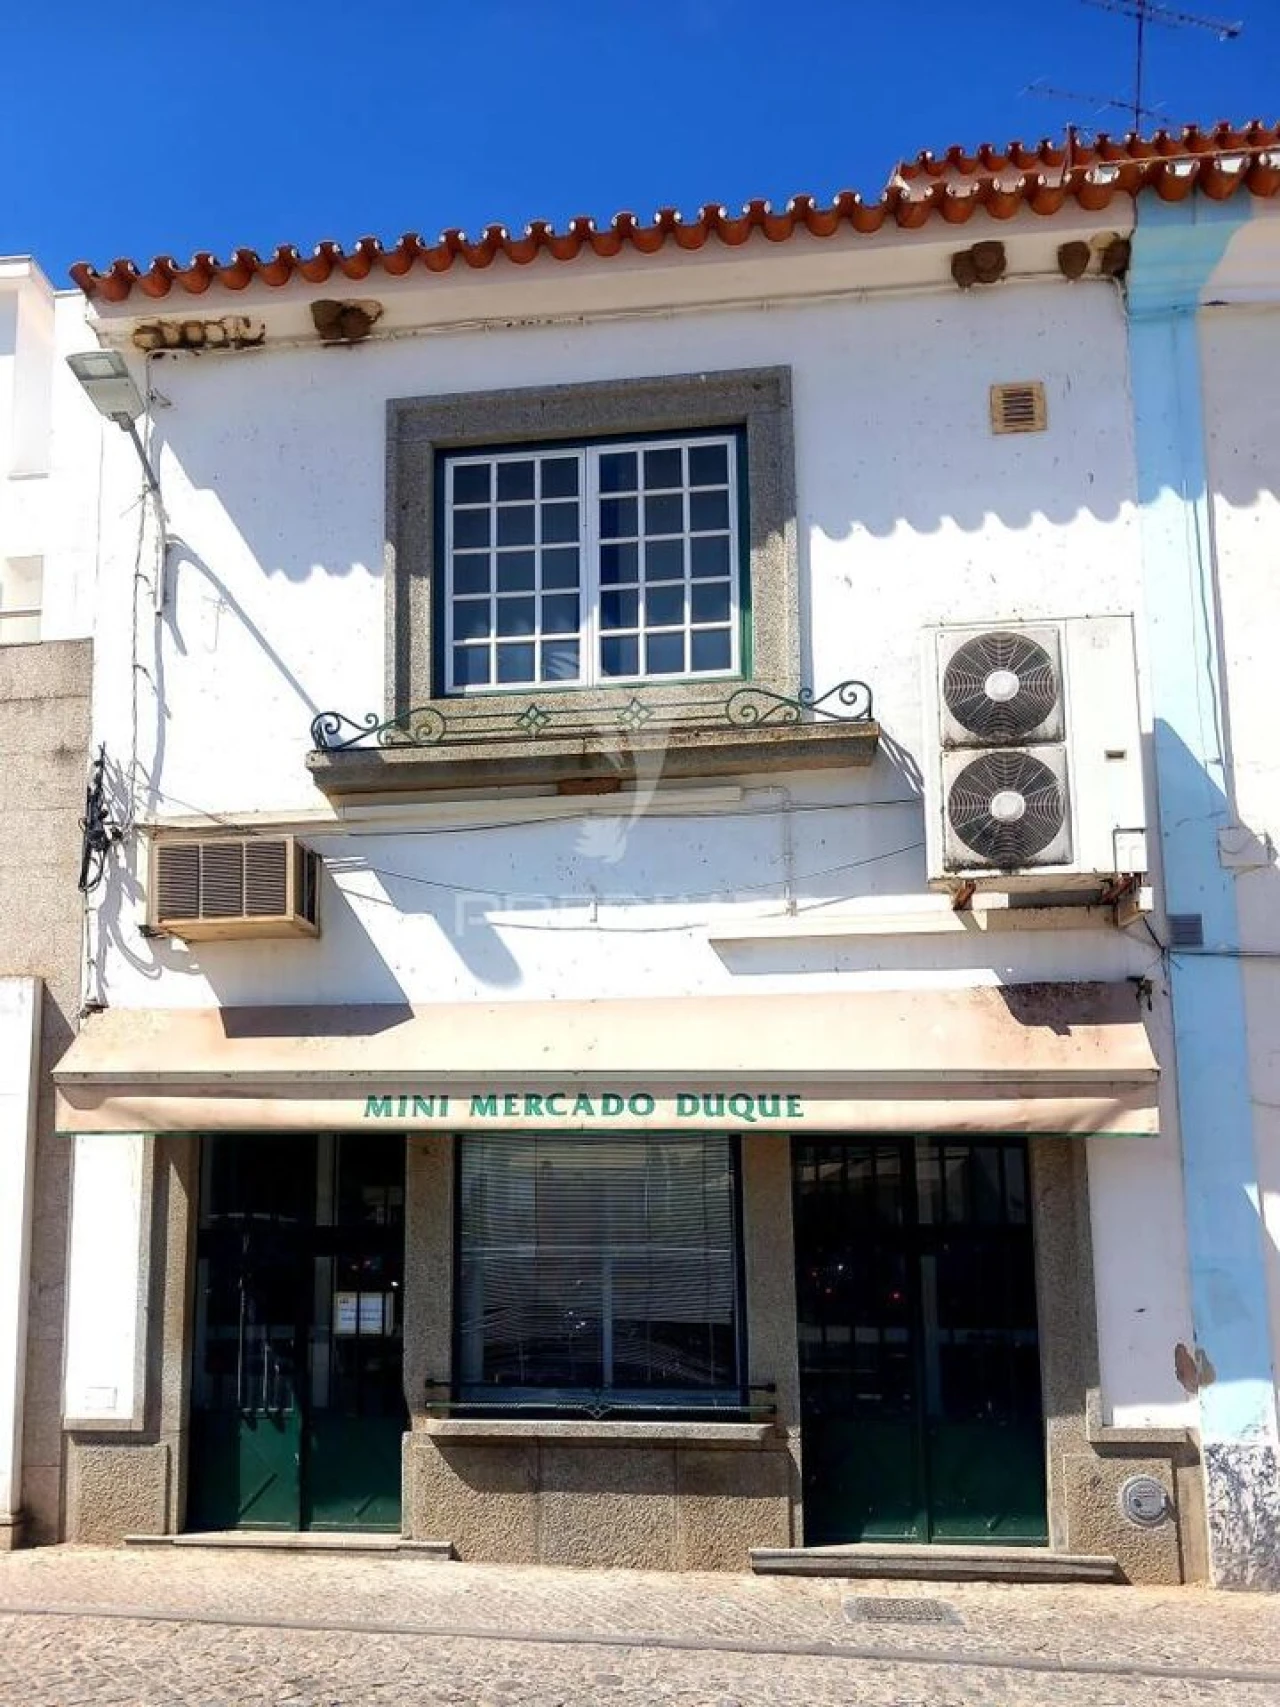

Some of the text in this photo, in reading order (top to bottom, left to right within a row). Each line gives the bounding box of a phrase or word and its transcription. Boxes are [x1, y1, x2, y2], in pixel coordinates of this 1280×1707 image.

[364, 1092, 804, 1122] MINI MERCADO DUQUE
